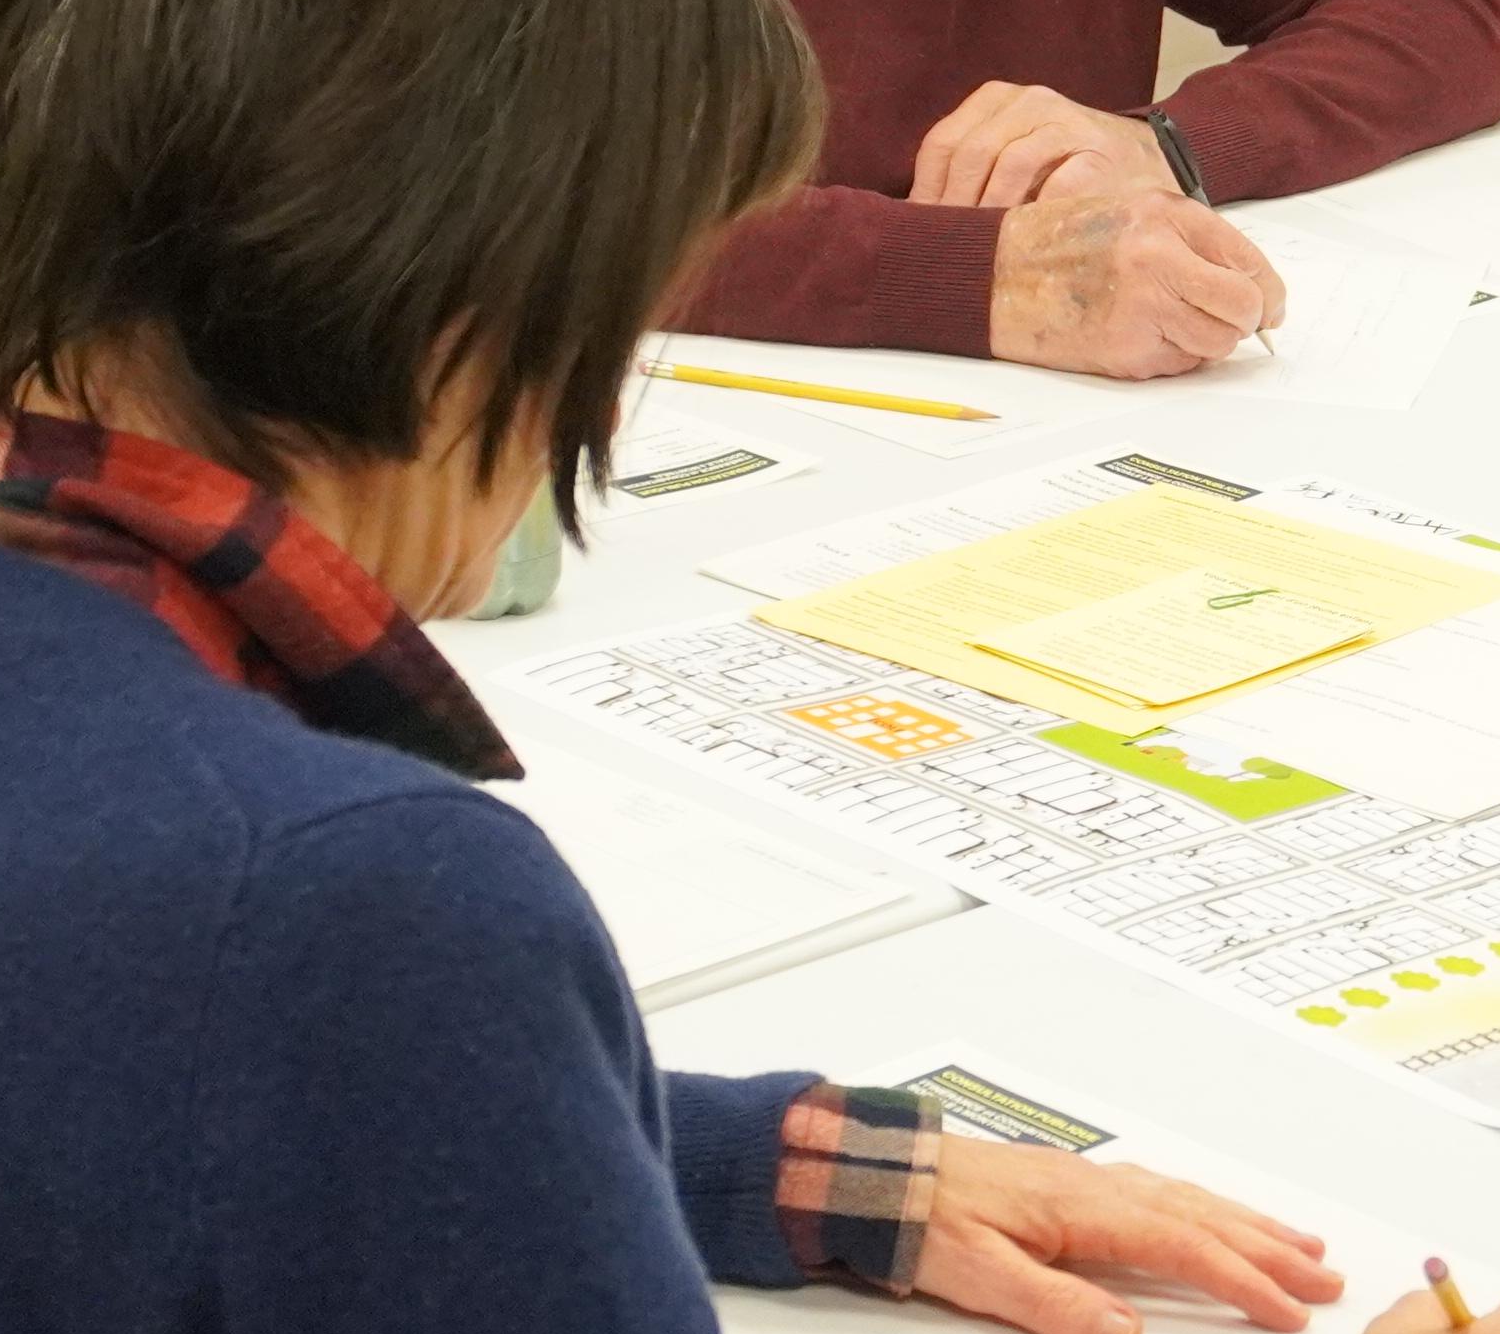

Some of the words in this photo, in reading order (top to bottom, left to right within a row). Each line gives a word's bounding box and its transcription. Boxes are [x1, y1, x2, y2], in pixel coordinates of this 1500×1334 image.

[1129, 456, 1202, 483] CONSULTATION
[940, 1069, 1041, 1121] CONSULTATION
[1038, 1110, 1102, 1143] PUBLIQUE
